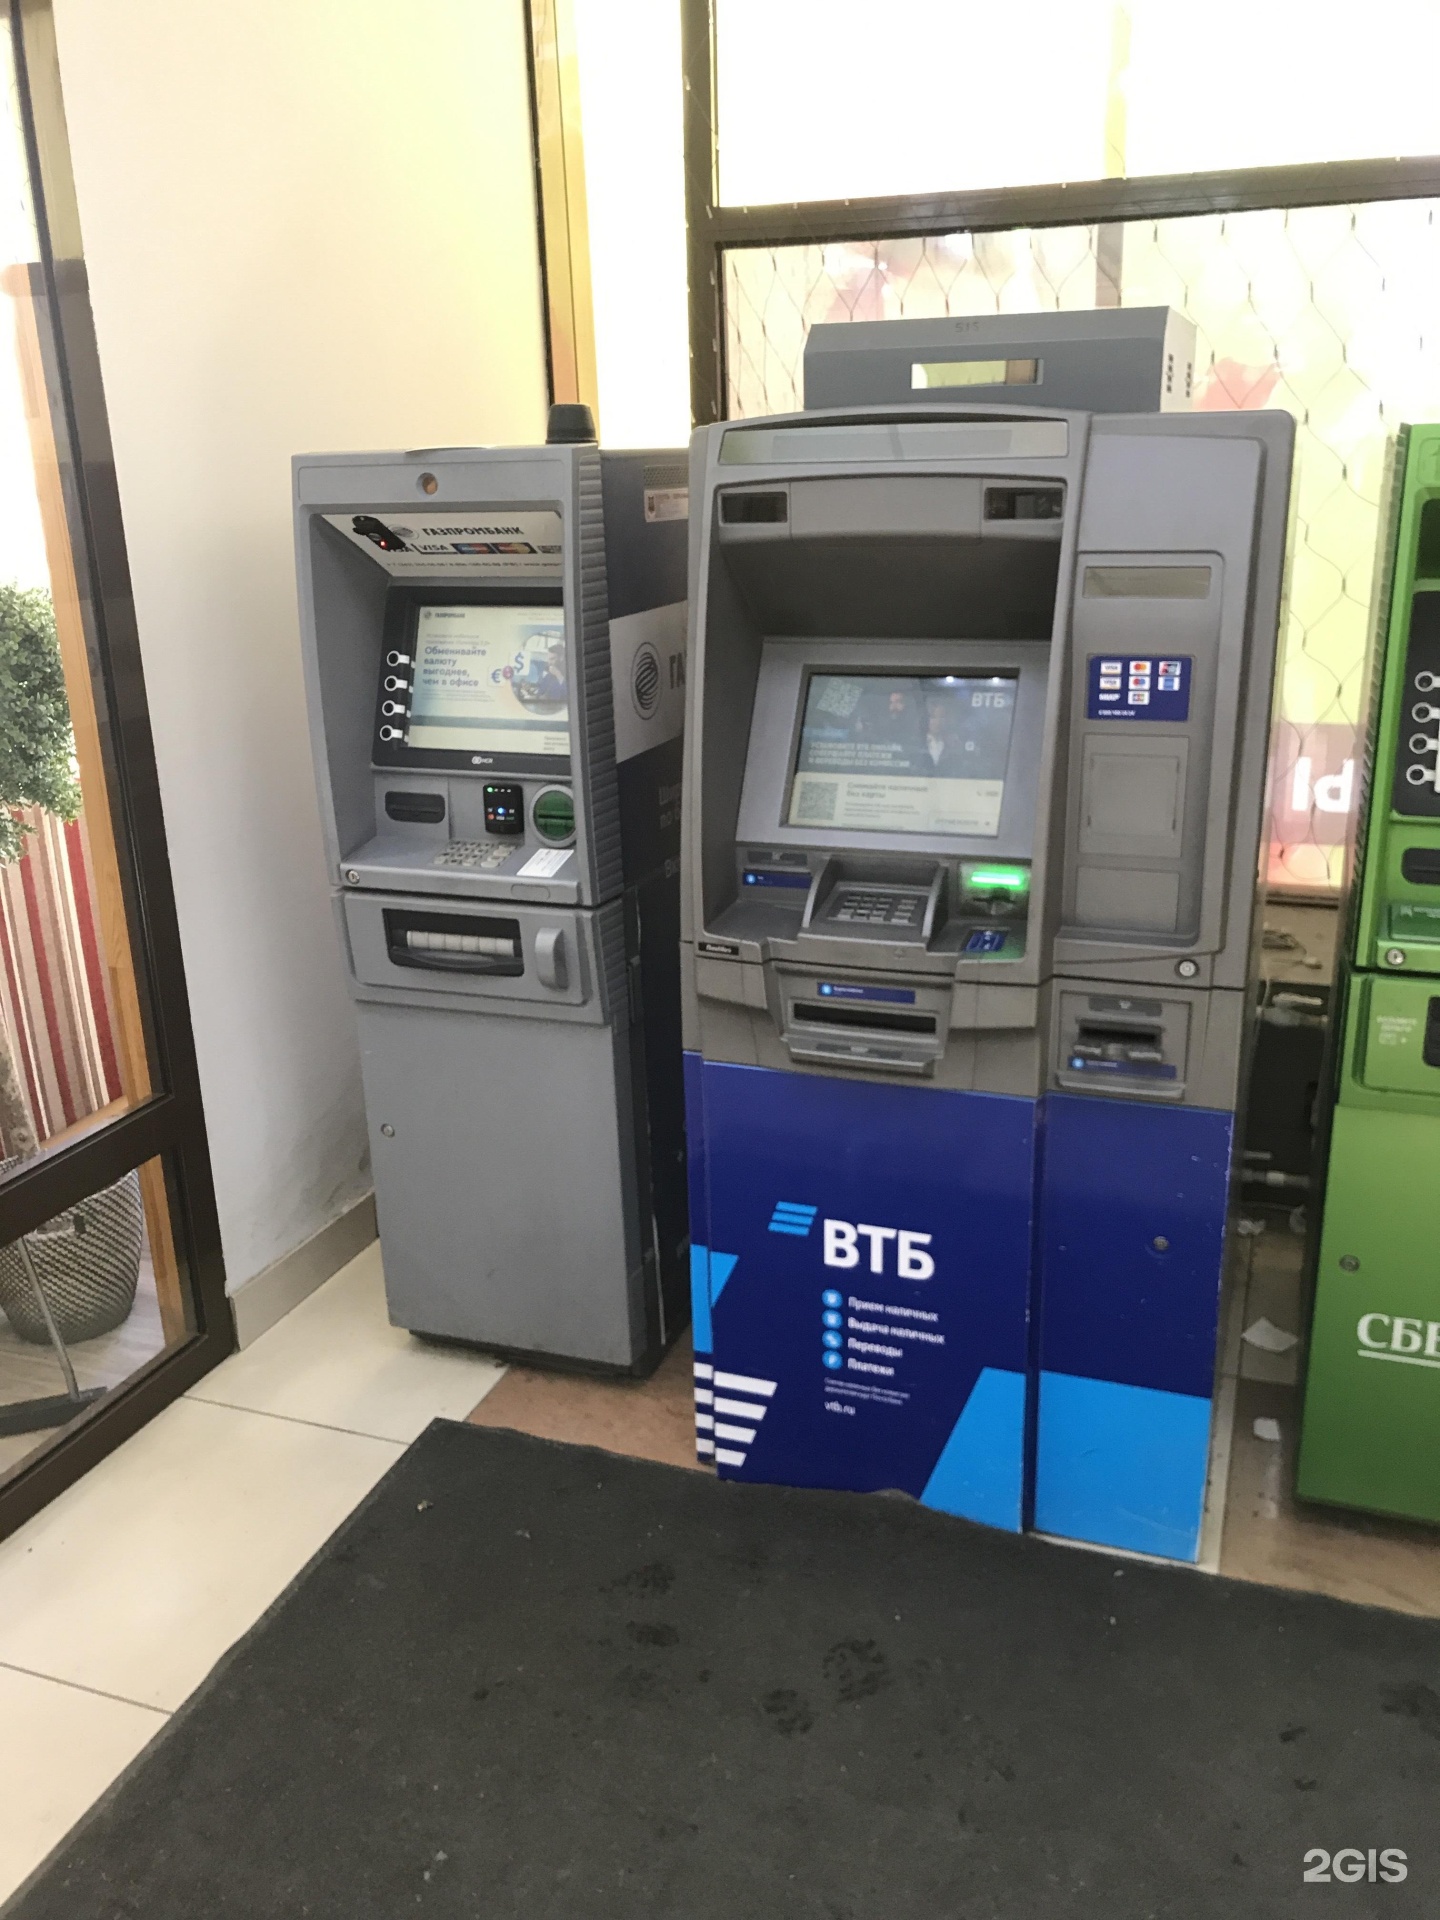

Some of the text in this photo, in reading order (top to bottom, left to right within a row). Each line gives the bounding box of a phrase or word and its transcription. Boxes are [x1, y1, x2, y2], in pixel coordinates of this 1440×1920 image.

[422, 526, 525, 536] ГАЗПРОМБАНК
[424, 646, 487, 656] Обменивайте
[424, 658, 457, 667] валюту
[423, 668, 470, 677] выгоднее,
[449, 677, 479, 687] офисе
[971, 691, 1006, 708] ВТБ
[823, 1218, 936, 1281] ВТБ
[884, 1304, 939, 1322] наличных
[847, 1316, 946, 1345] Выдача наличных
[847, 1337, 904, 1358] Переводы
[847, 1357, 895, 1376] Платежи
[824, 1400, 856, 1416] vtb.ru
